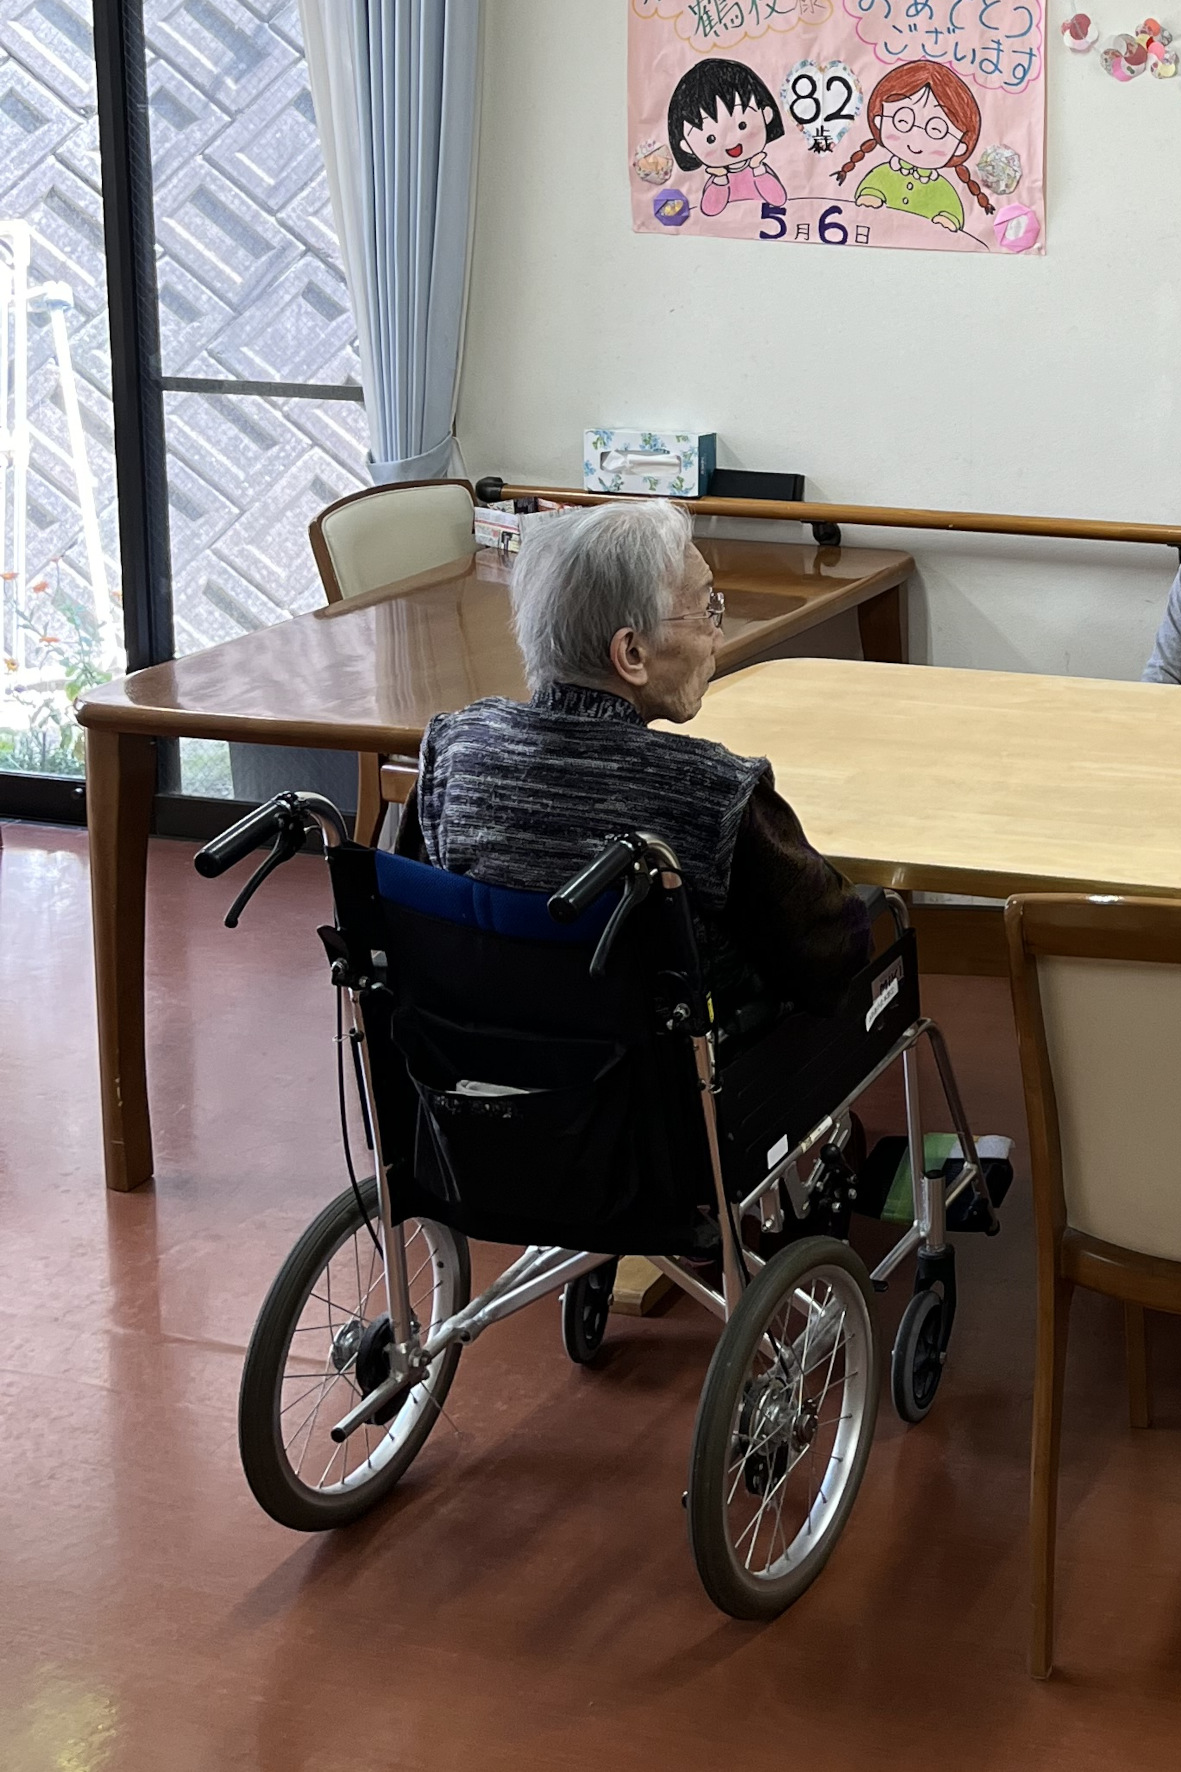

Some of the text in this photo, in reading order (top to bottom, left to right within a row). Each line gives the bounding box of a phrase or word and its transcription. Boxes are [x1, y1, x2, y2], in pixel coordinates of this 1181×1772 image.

[884, 23, 1037, 86] ございます
[790, 74, 855, 124] 82
